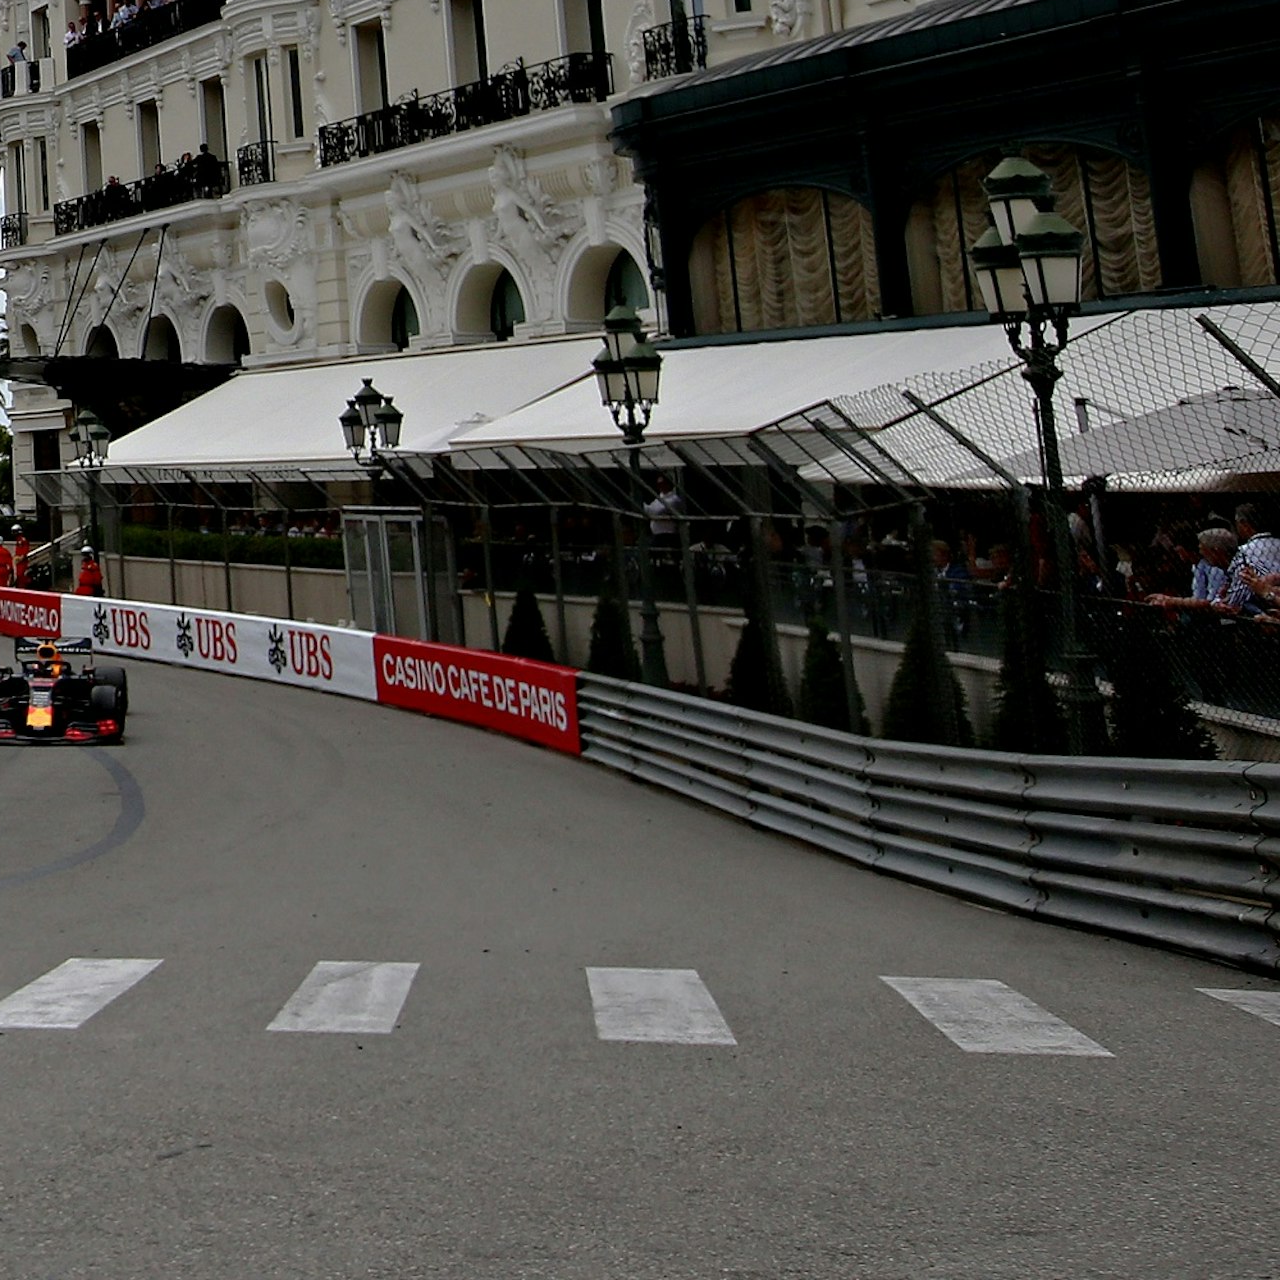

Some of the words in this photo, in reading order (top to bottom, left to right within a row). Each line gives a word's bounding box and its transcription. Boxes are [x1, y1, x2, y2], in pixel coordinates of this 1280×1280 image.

[0, 599, 59, 632] MONTE-CARLO
[111, 608, 151, 651] UBS
[195, 618, 237, 664] UBS
[288, 630, 333, 680] UBS
[382, 653, 446, 695] CASINO
[447, 664, 493, 708] CAFE
[492, 675, 519, 715] DE
[518, 681, 568, 731] PARIS
